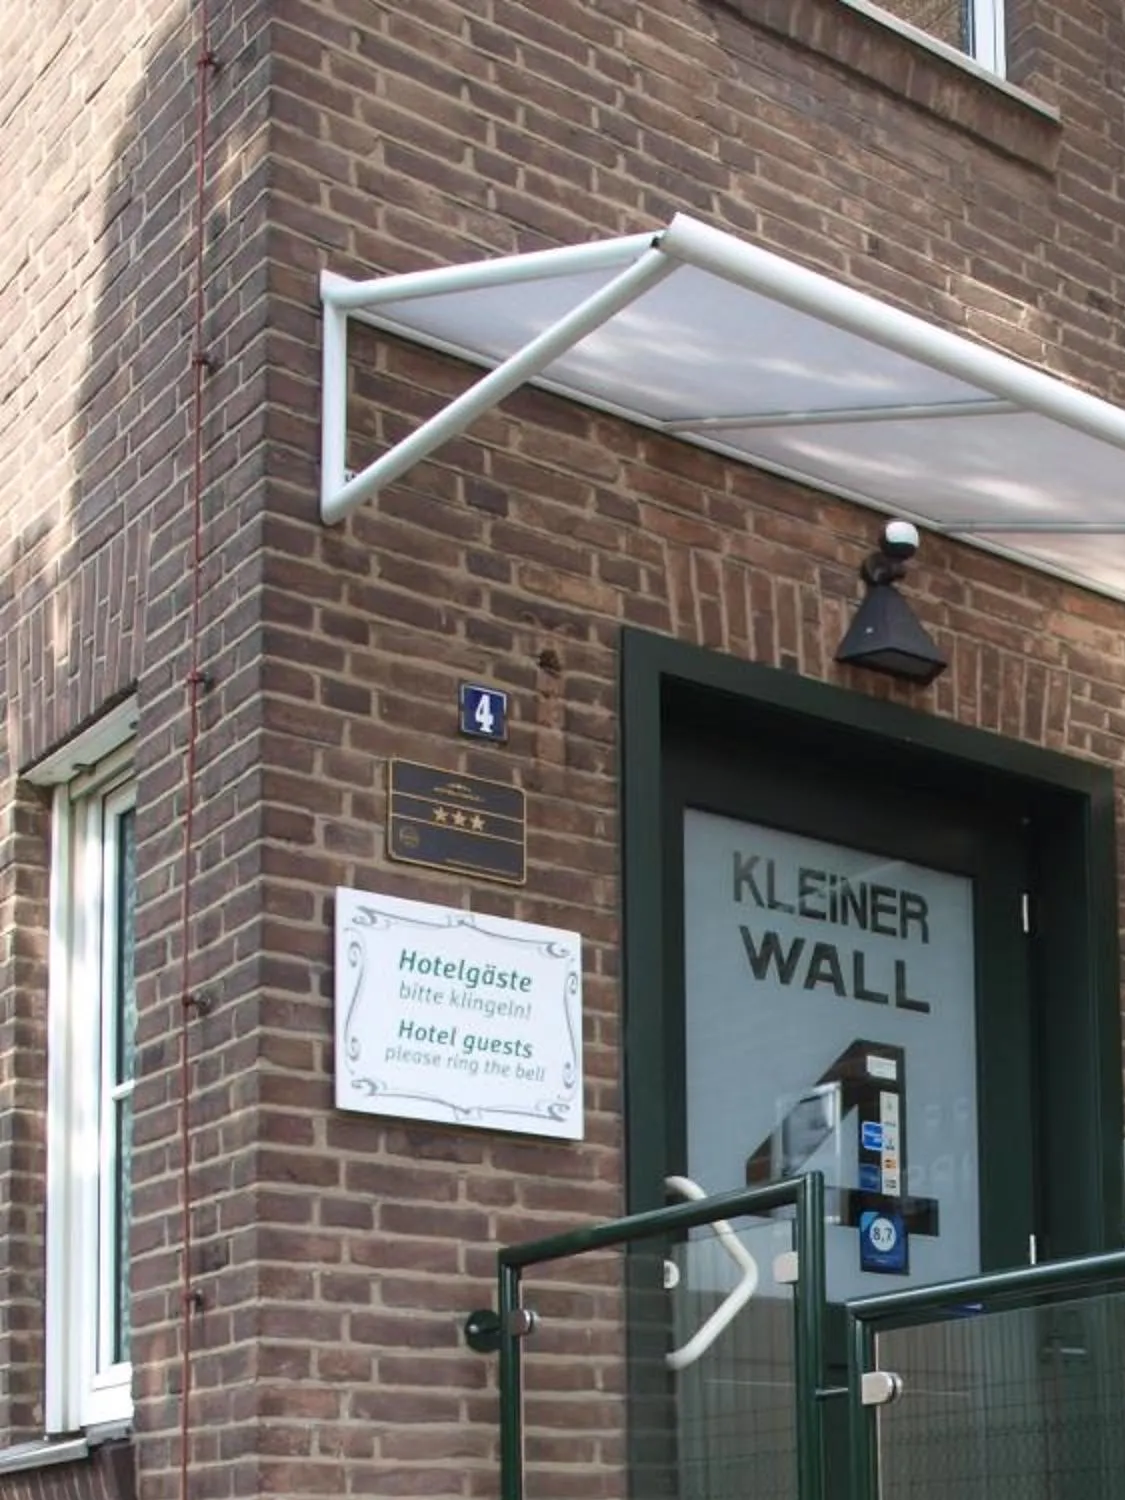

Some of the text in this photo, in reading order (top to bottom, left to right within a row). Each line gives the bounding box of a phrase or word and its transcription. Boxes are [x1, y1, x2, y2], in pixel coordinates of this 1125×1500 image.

[474, 693, 494, 733] 4
[399, 948, 533, 993] Hotelgäste
[738, 925, 931, 1014] WALL
[399, 980, 533, 1020] bitte klingeln!
[398, 1019, 534, 1059] Hotel guests
[384, 1045, 546, 1082] please ring the bell
